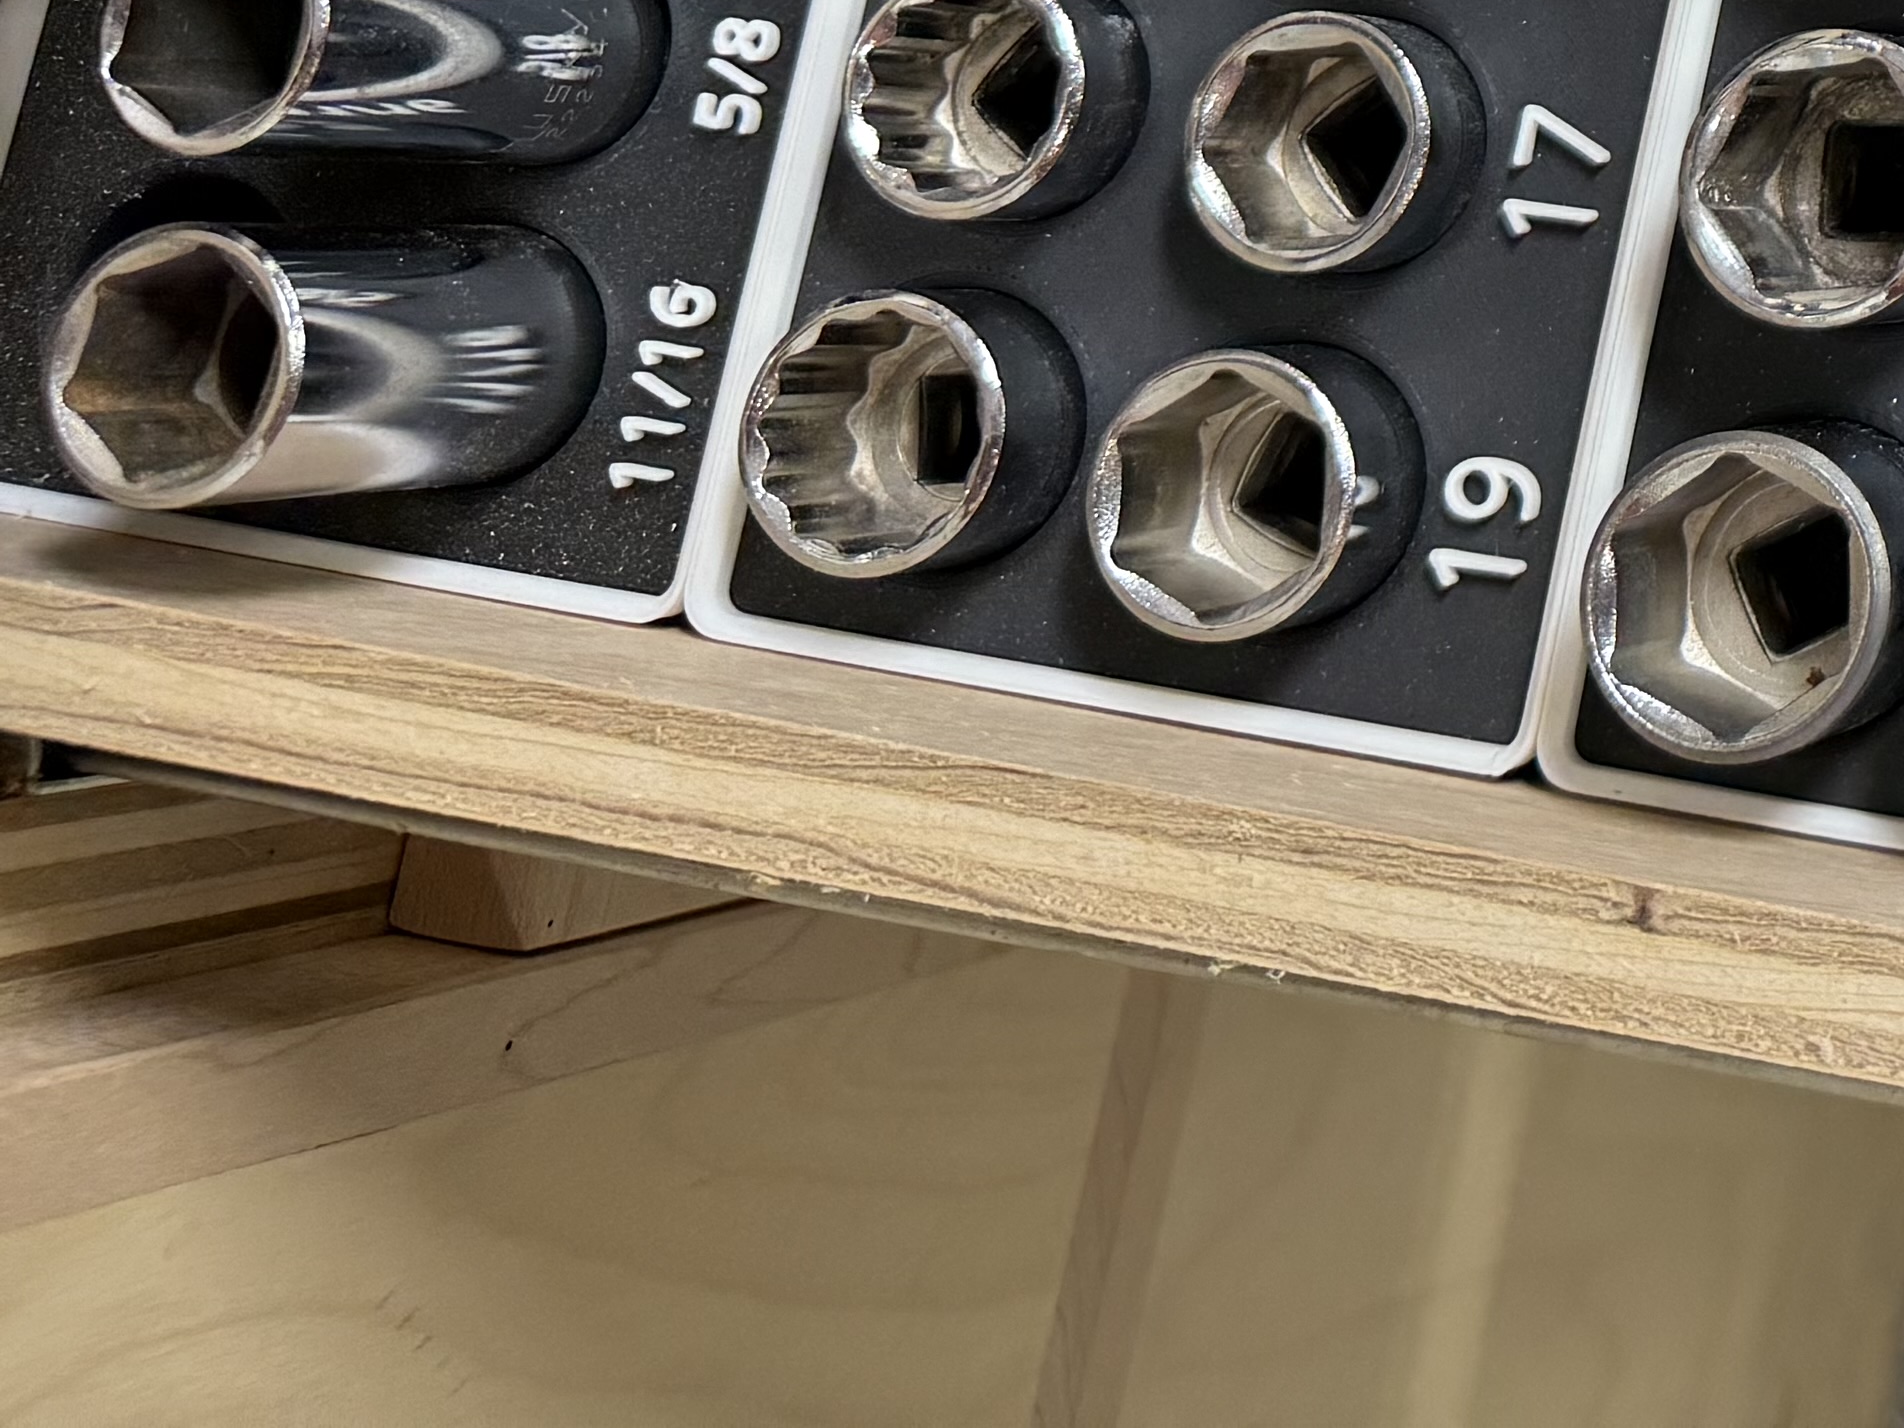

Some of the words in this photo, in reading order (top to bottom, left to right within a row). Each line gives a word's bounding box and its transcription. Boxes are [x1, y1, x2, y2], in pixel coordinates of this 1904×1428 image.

[692, 16, 781, 135] 5/8
[1501, 103, 1611, 235] 17
[608, 278, 717, 489] 11/16
[1427, 456, 1542, 587] 19
